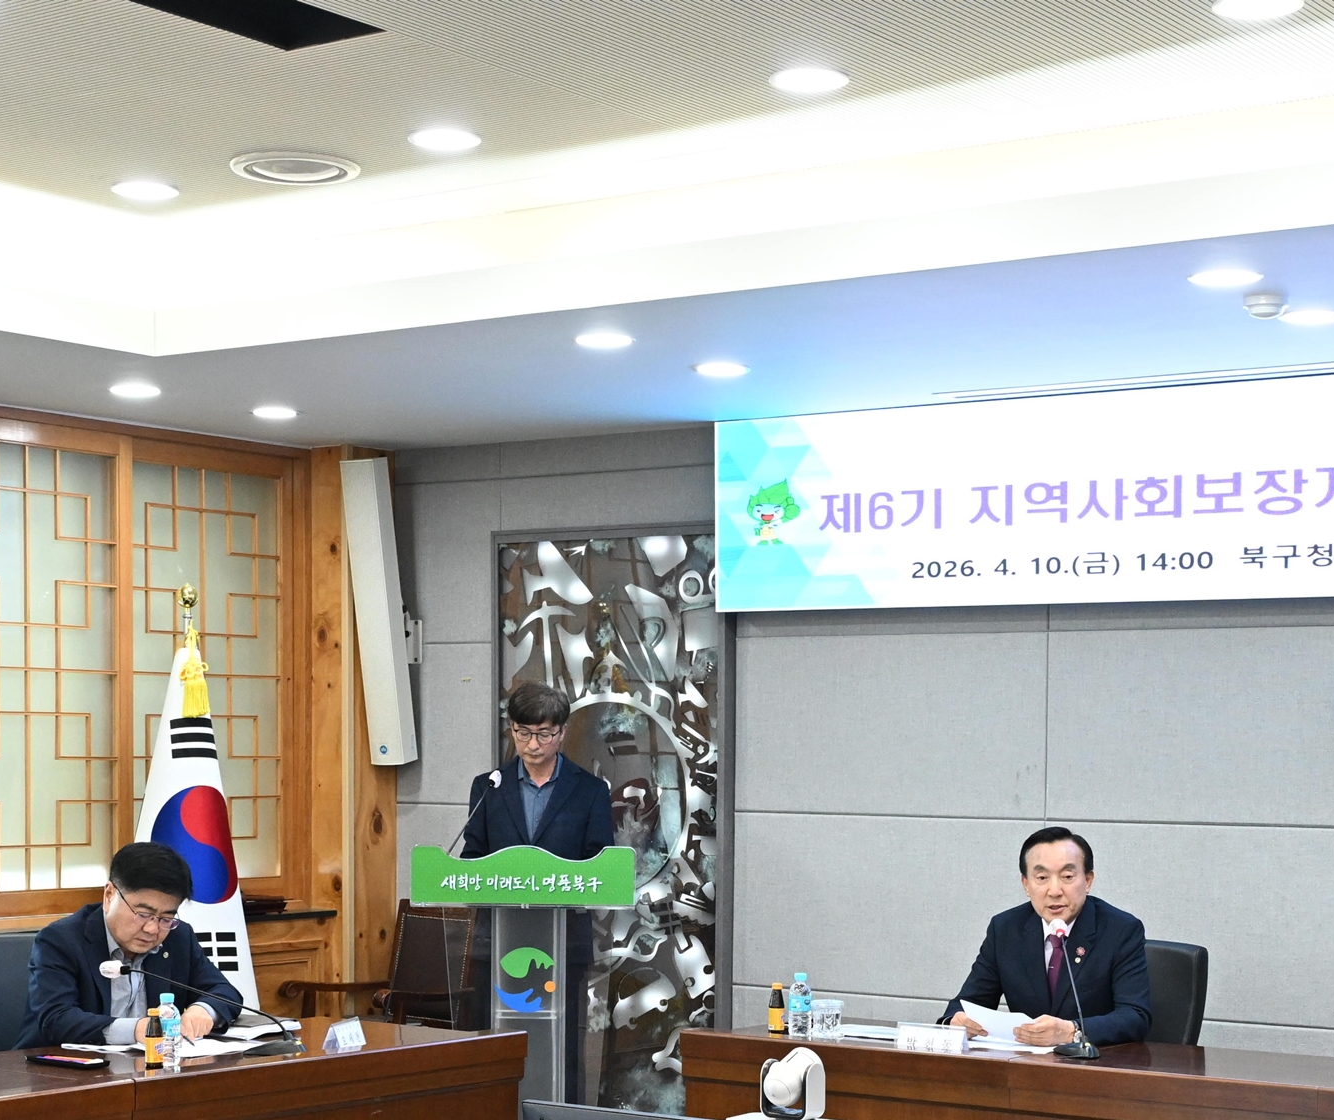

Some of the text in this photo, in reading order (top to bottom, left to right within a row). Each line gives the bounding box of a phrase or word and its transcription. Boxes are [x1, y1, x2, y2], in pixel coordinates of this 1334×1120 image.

[818, 488, 943, 534] 제6기
[911, 559, 983, 579] 2026.
[993, 558, 1017, 576] 4.
[1031, 551, 1121, 577] 10.(금)
[1136, 551, 1214, 571] 14:00
[1239, 543, 1334, 570] 북구청
[440, 873, 483, 891] 새희망
[542, 873, 603, 893] 명품북구
